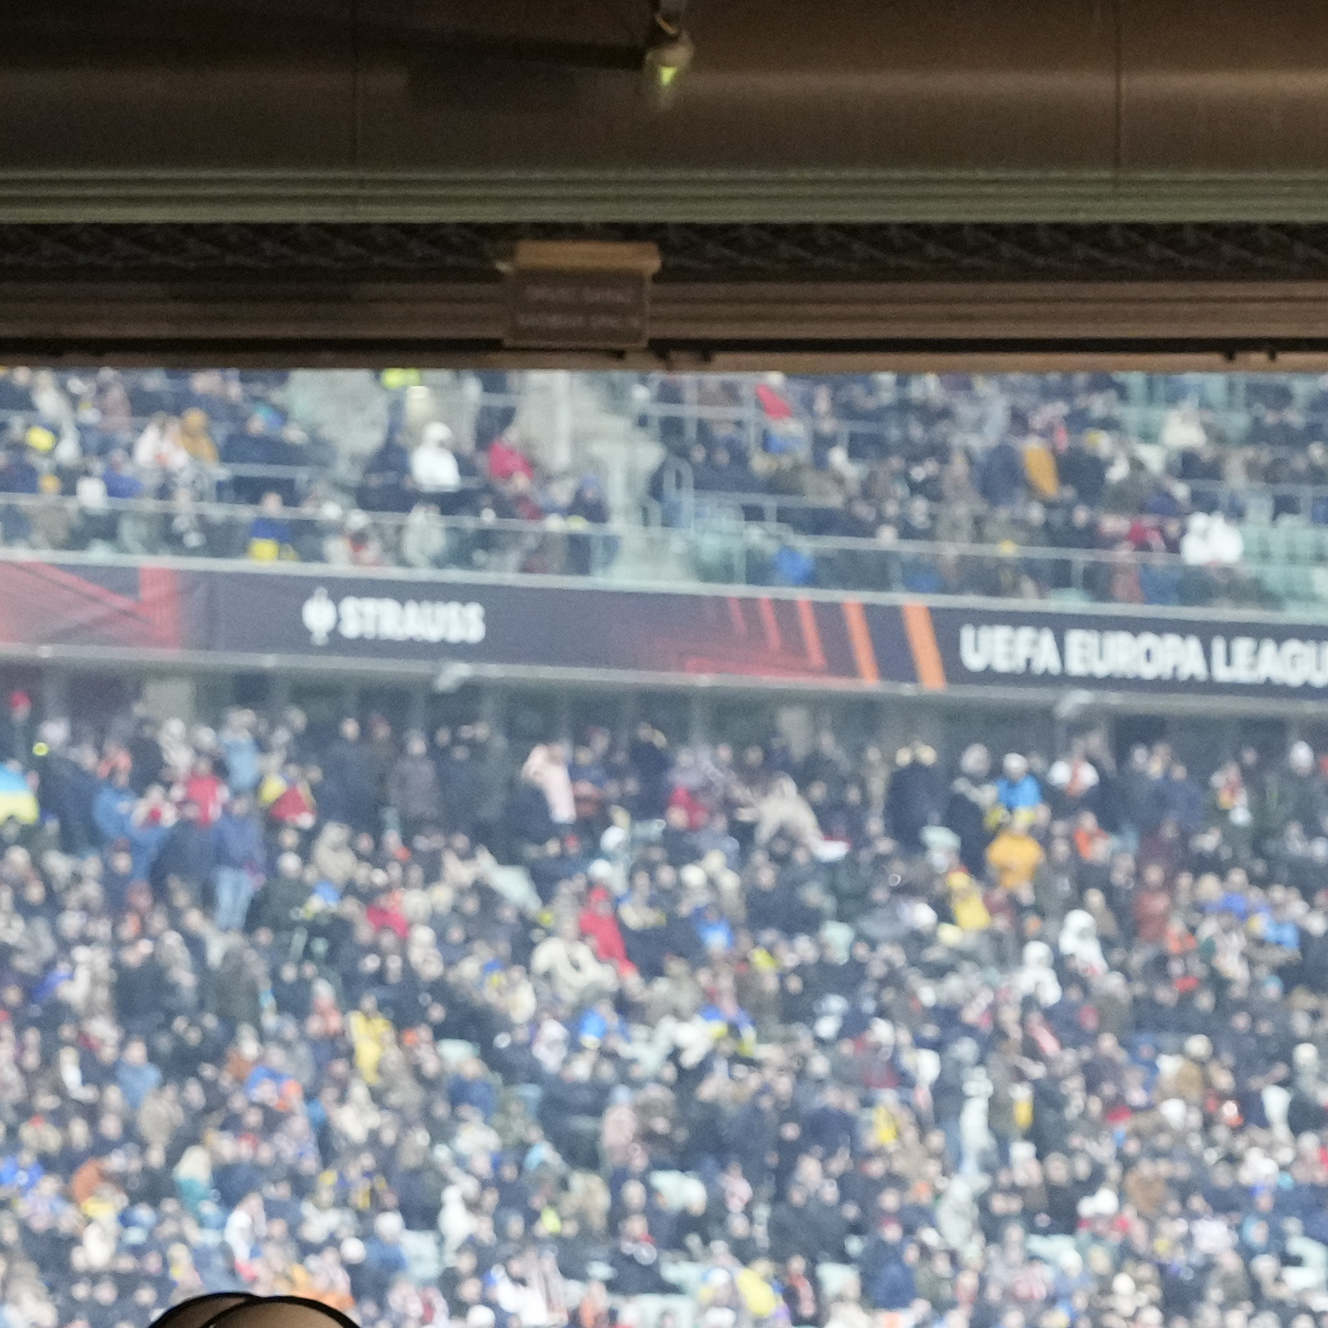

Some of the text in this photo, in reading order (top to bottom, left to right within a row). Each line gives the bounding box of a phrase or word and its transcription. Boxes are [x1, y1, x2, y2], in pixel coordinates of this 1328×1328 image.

[338, 595, 486, 643] STRAUSS
[960, 624, 1062, 675] UEFA
[1064, 629, 1209, 681] EUROPA
